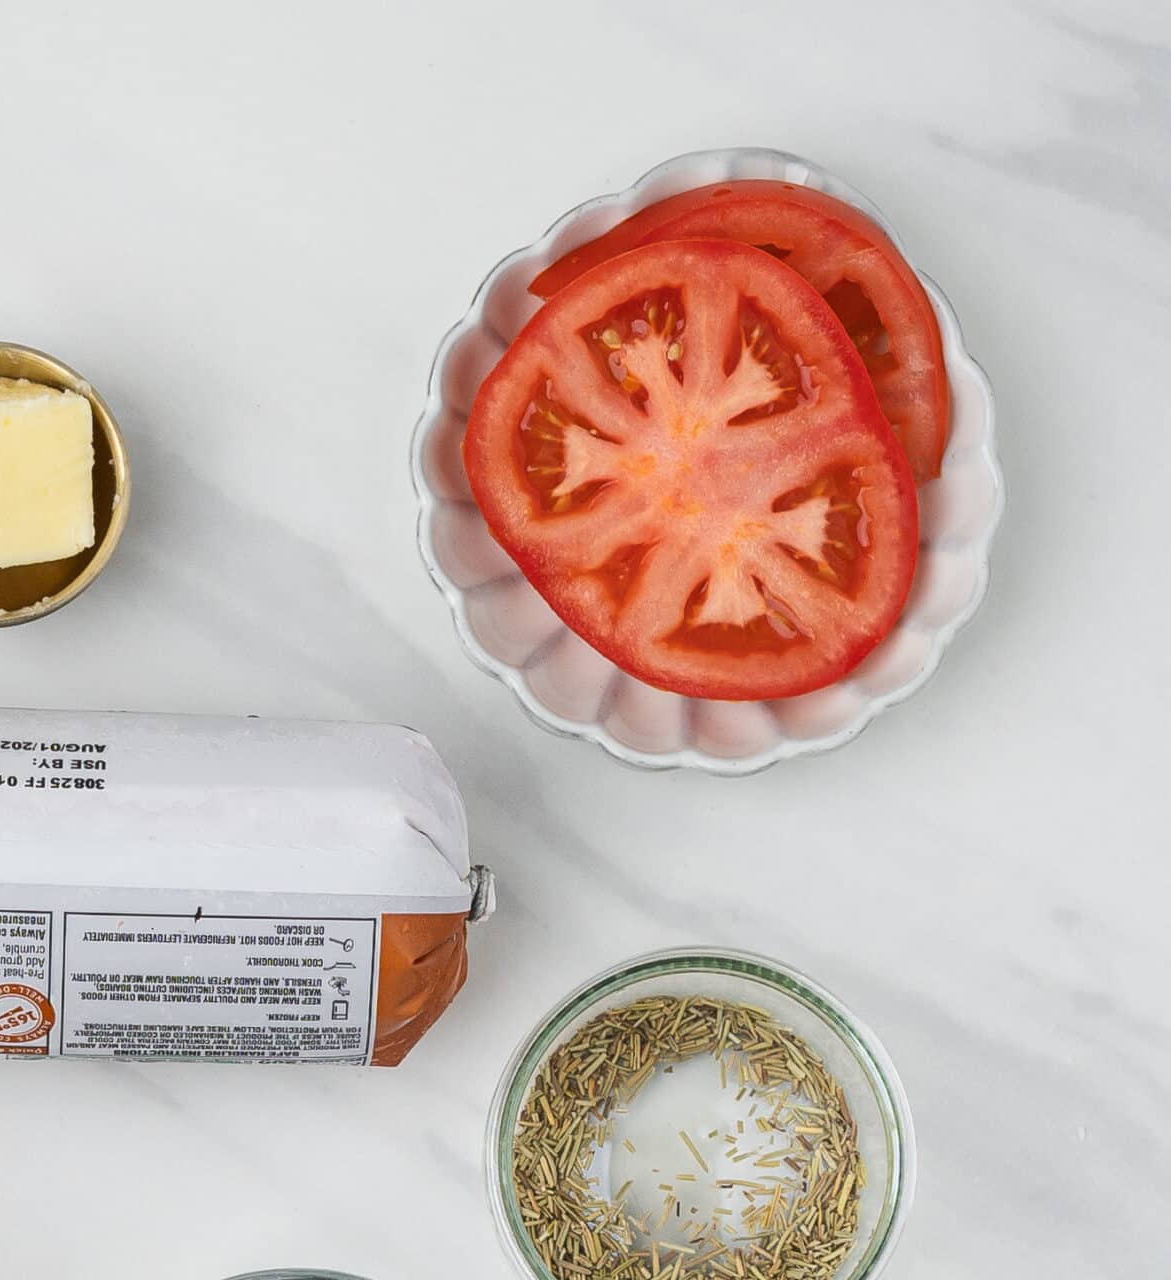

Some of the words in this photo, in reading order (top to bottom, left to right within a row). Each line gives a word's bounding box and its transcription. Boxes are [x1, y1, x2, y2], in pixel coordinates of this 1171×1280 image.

[33, 759, 63, 768] BY:
[71, 760, 106, 770] USE
[25, 777, 45, 788] FF
[50, 778, 105, 789] 30825
[10, 927, 46, 940] Always
[274, 925, 311, 934] DISCARD.
[314, 926, 324, 935] OR
[83, 932, 135, 942] IMMEDIATELY
[137, 933, 181, 943] LEFTOVERS
[184, 934, 236, 944] REFRIGERATE
[238, 936, 256, 945] HOT.
[258, 936, 284, 945] FOODS
[287, 937, 302, 946] HOT
[304, 937, 324, 946] KEEP
[2, 943, 45, 955] crumble,
[26, 958, 45, 967] Add
[245, 957, 299, 966] THOROUGHLY.
[301, 958, 323, 967] COOK
[4, 968, 44, 979] Pre-heat
[70, 973, 107, 982] POULTRY.
[109, 974, 120, 982] OR
[145, 975, 163, 983] RAW
[166, 976, 205, 984] TOUCHING
[208, 976, 232, 984] AFTER
[235, 977, 261, 985] HANDS
[282, 977, 322, 986] UTENSILS,
[134, 984, 167, 992] CUTTING
[216, 987, 257, 995] SURFACES
[78, 992, 107, 1000] FOODS.
[204, 995, 238, 1003] POULTRY
[241, 996, 256, 1004] AND
[302, 997, 321, 1005] KEEP
[17, 1020, 52, 1042] ALWAYS
